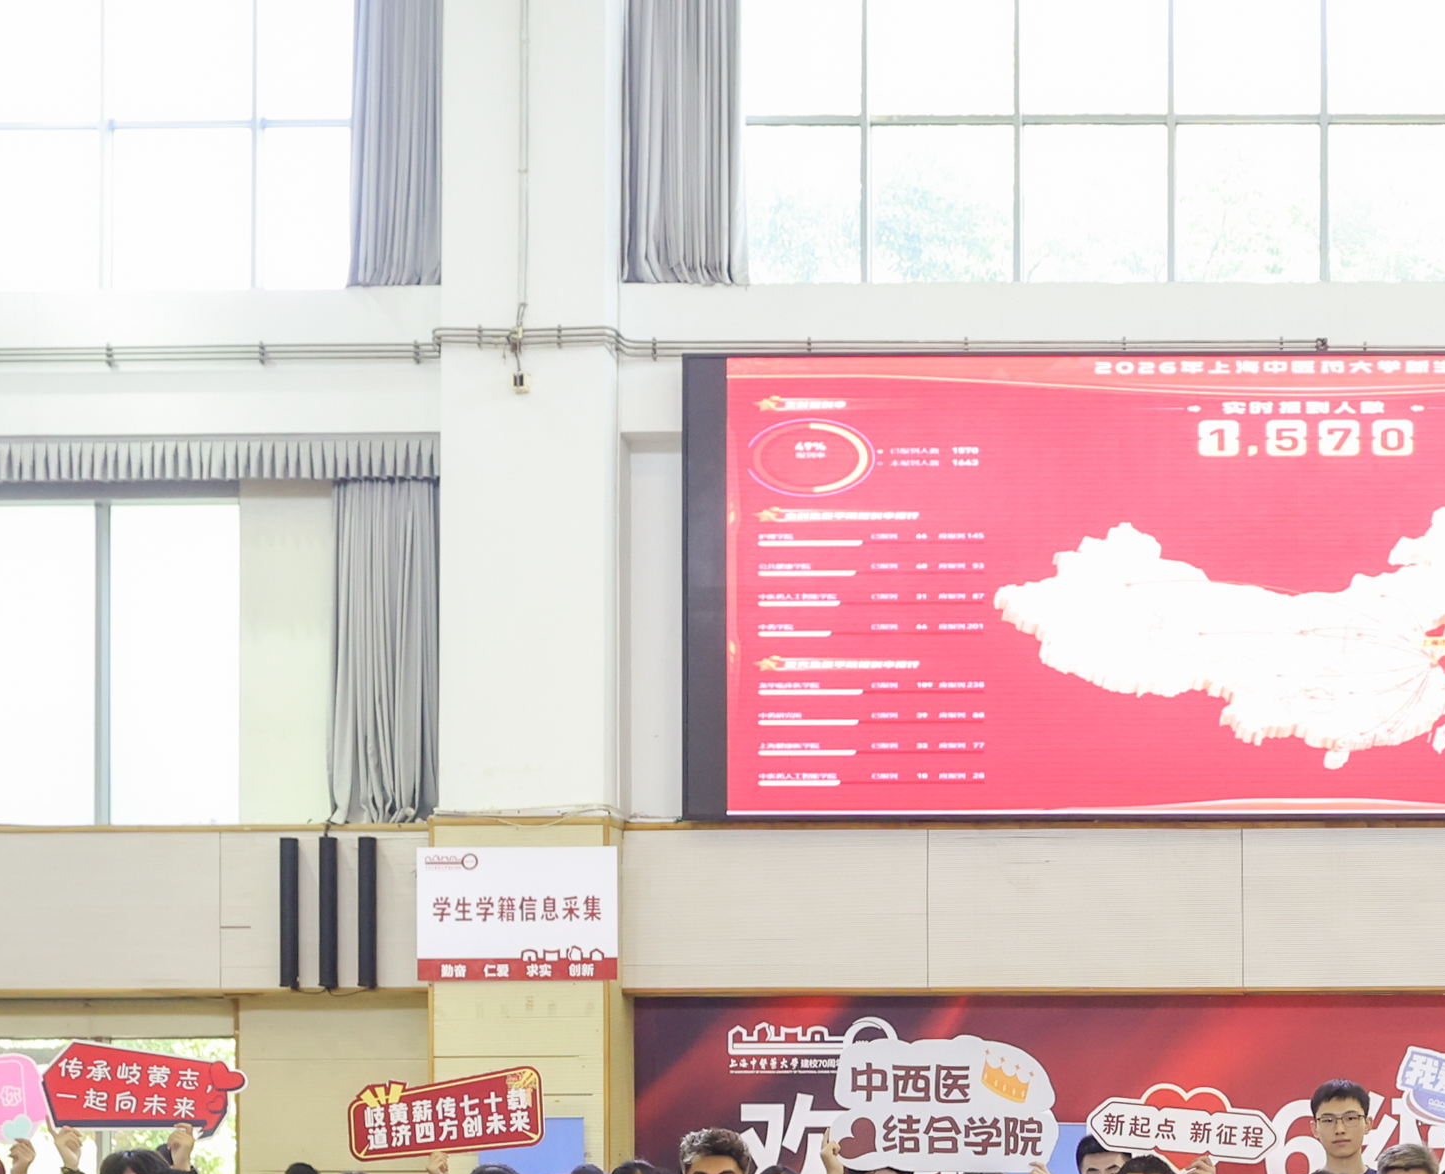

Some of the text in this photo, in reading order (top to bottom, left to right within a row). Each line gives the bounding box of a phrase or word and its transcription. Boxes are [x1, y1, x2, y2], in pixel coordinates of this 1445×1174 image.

[1223, 401, 1385, 415] 实时报到人数
[432, 895, 602, 922] 学生学籍信息采集
[441, 964, 594, 978] 勤奋 仁爱 求实 创新
[850, 1062, 971, 1104] 中西医
[56, 1088, 196, 1119] 一起向未来
[363, 1088, 528, 1128] 岐黄薪传七十载
[367, 1110, 531, 1150] 道济四方创未来
[883, 1114, 1044, 1157] 结合学院
[1103, 1112, 1264, 1149] 新起点 新征程
